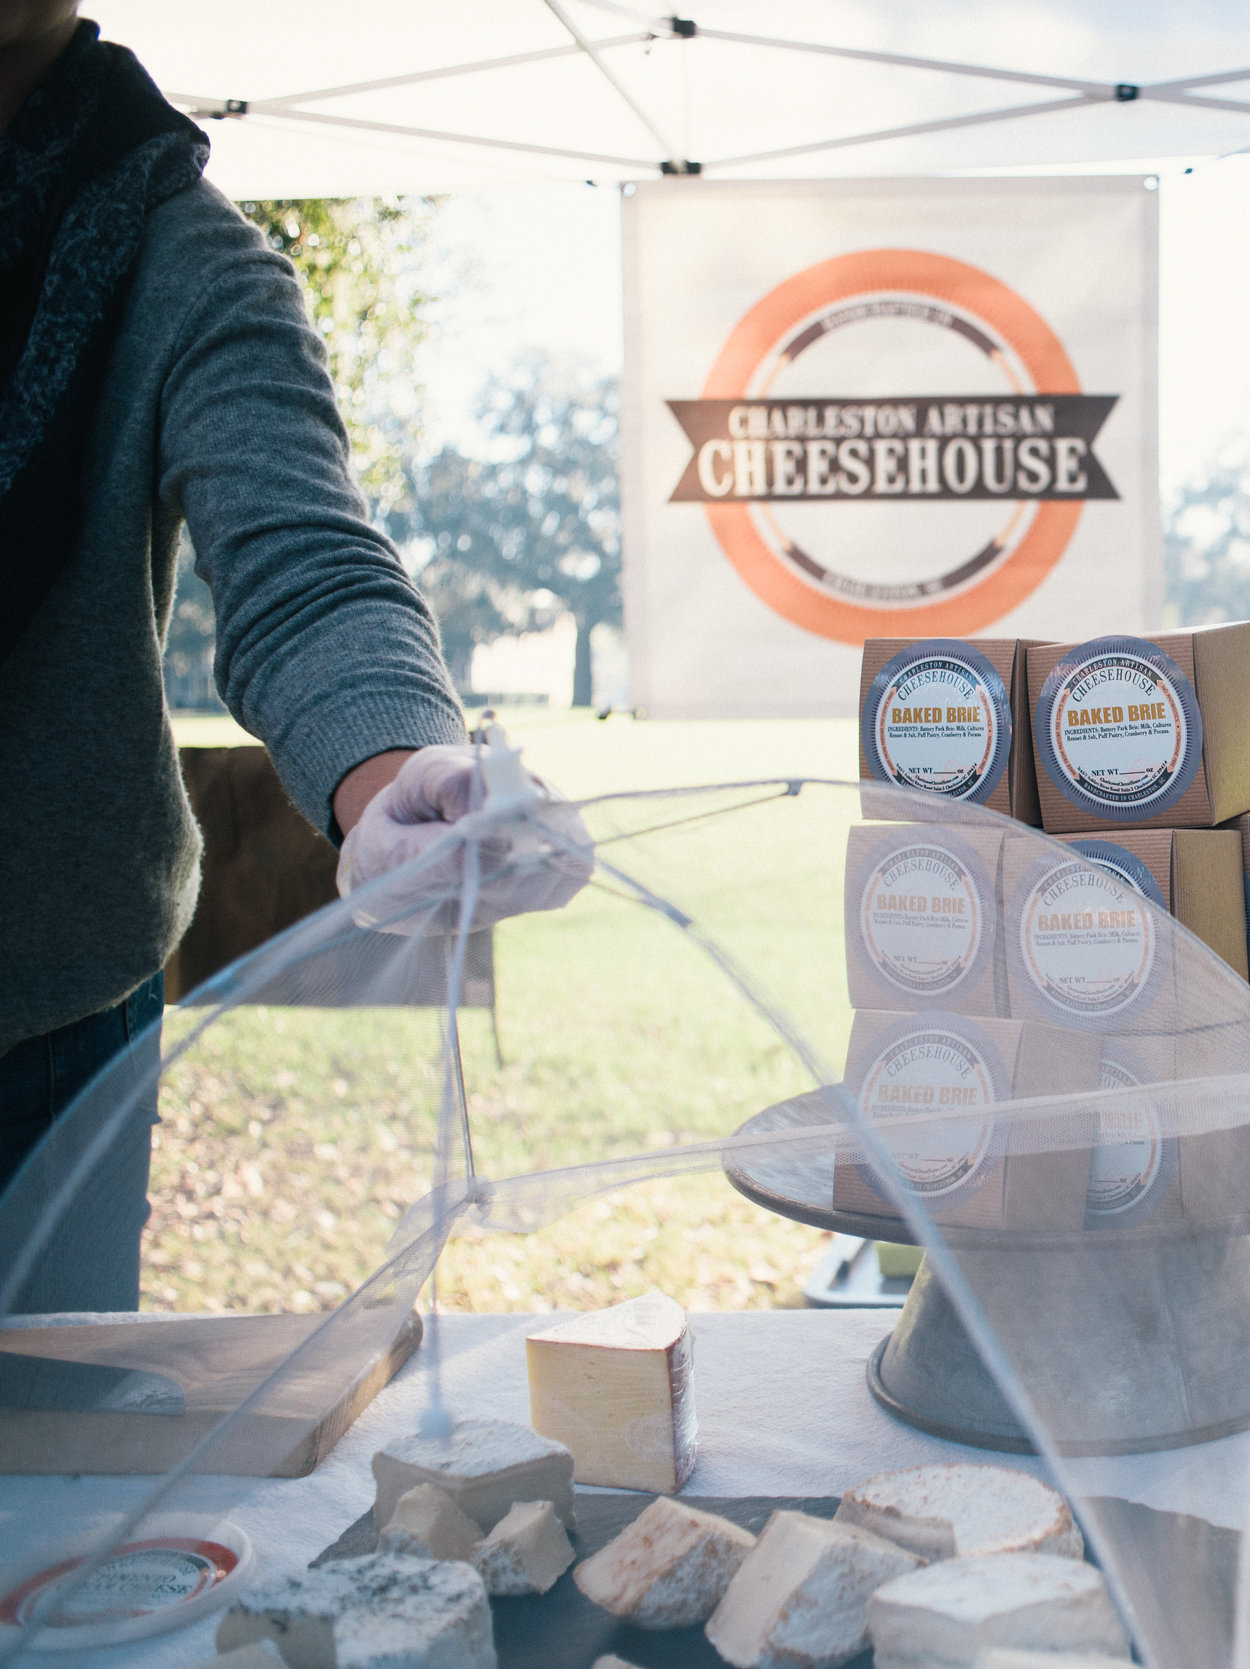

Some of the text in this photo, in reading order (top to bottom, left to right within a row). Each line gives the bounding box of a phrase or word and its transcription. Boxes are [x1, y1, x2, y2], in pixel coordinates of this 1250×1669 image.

[727, 403, 1055, 439] CHARLESTON ARTISAN
[697, 437, 1089, 498] CHEESEHOUSE
[897, 670, 974, 701] CHEESEHOUSE
[1072, 659, 1153, 686] CHARLESTON ARTISAN
[1072, 668, 1156, 702] CHEESEHOUSE
[892, 706, 981, 724] BAKED BRIE
[1067, 702, 1167, 727] BAKED BRIE
[883, 859, 960, 890] CHEESEHOUSE
[1043, 873, 1124, 907] CHEESEHOUSE
[876, 893, 966, 915] BAKED BRIE
[1038, 910, 1137, 932] BAKED BRIE
[886, 1046, 972, 1080] CHEESEHOUSE
[877, 1084, 978, 1105] BAKED BRIE
